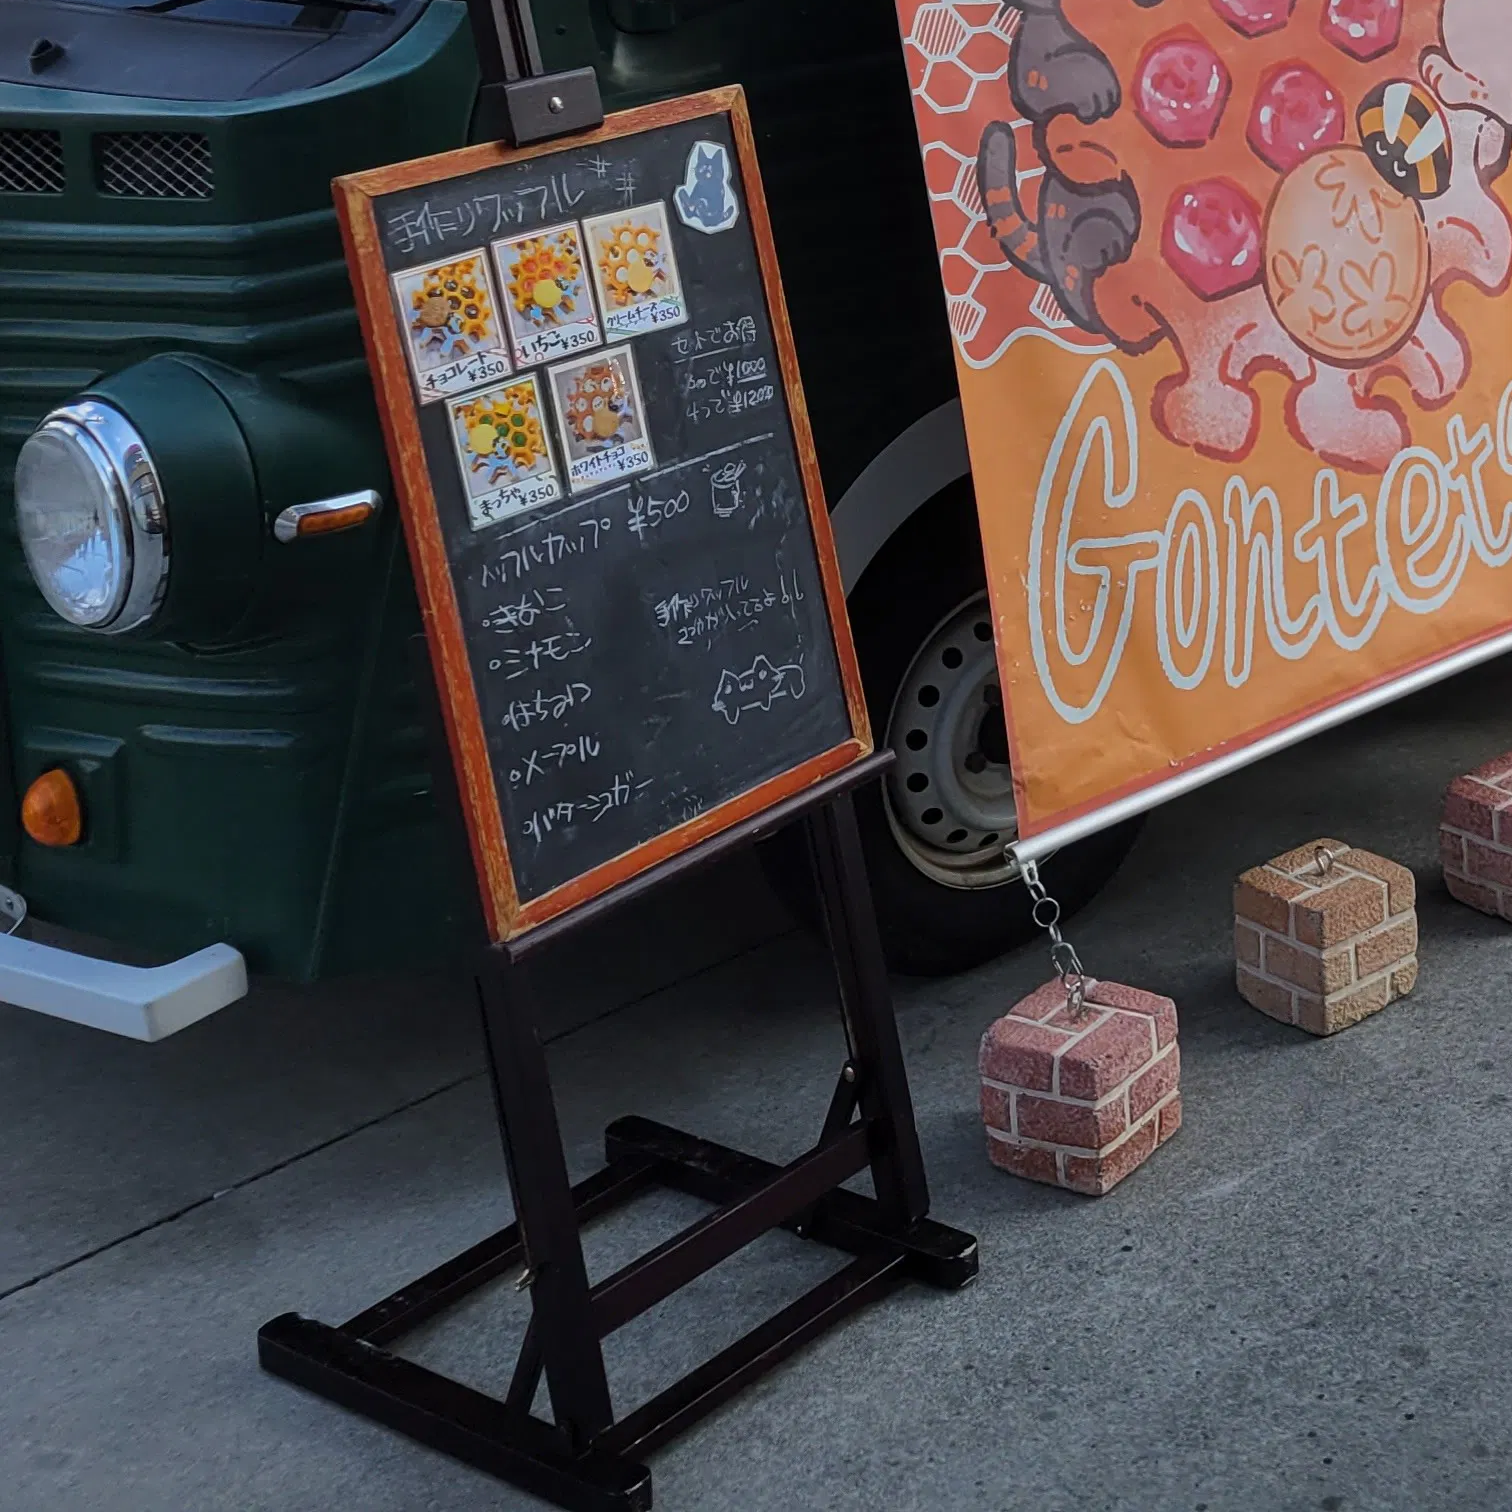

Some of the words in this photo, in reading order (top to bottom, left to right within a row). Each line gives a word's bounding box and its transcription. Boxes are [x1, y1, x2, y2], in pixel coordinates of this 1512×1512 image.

[388, 173, 585, 253] 手作りワッフル
[650, 305, 681, 324] ¥350
[523, 333, 561, 359] いちご
[561, 330, 595, 351] ¥350
[425, 350, 488, 390] チョコレート
[467, 360, 505, 383] ¥350
[571, 446, 626, 478] ホワイトチョコ
[618, 451, 649, 472] ¥350
[519, 484, 555, 507] ¥350
[627, 489, 690, 540] ¥500
